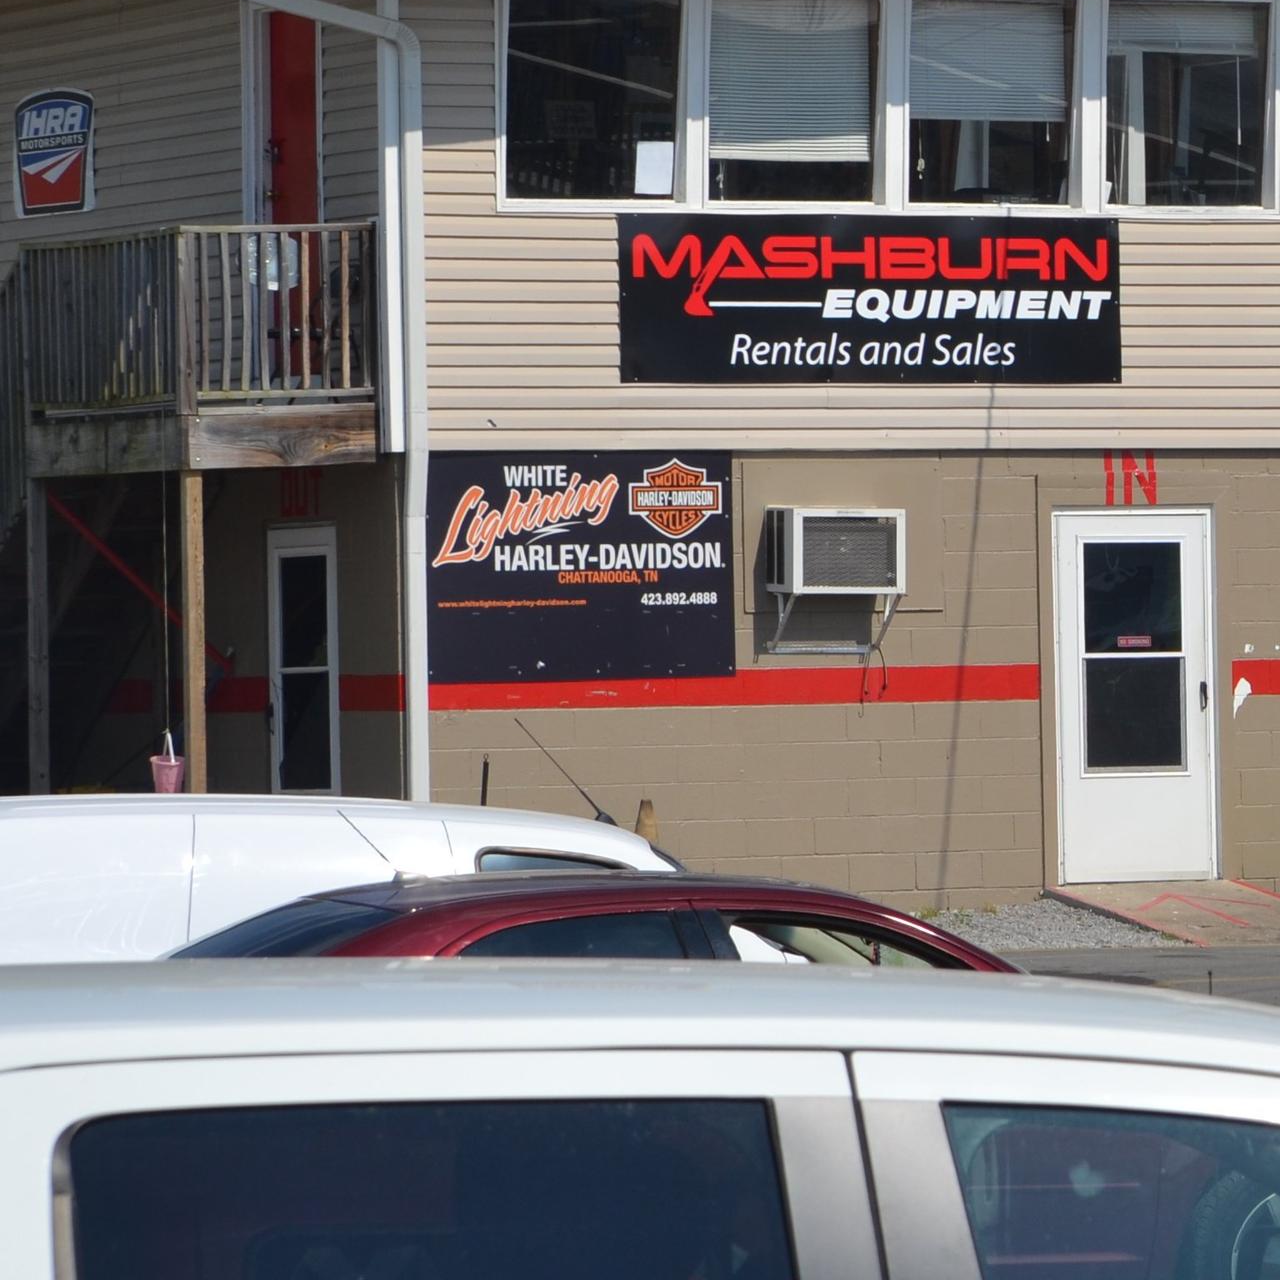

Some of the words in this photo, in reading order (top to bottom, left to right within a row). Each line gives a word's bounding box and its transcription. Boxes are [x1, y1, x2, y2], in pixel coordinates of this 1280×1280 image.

[22, 106, 84, 137] IHRA
[21, 134, 84, 150] MOTORSPORTS
[632, 234, 1108, 281] MASHBURN
[822, 288, 1112, 322] EQUIPMENT
[730, 332, 851, 366] Rentals
[858, 333, 926, 366] and
[933, 332, 1016, 366] Sales
[503, 465, 567, 487] WHITE
[655, 475, 696, 486] MOTOR
[1104, 449, 1157, 506] IN
[637, 490, 714, 507] HARLEY-DAVIDSON
[432, 472, 620, 568] Lightning
[655, 511, 697, 529] CYCLES
[558, 570, 641, 585] CHATTANOOGA,
[643, 570, 658, 583] TN
[641, 591, 718, 606] 423.892.4888
